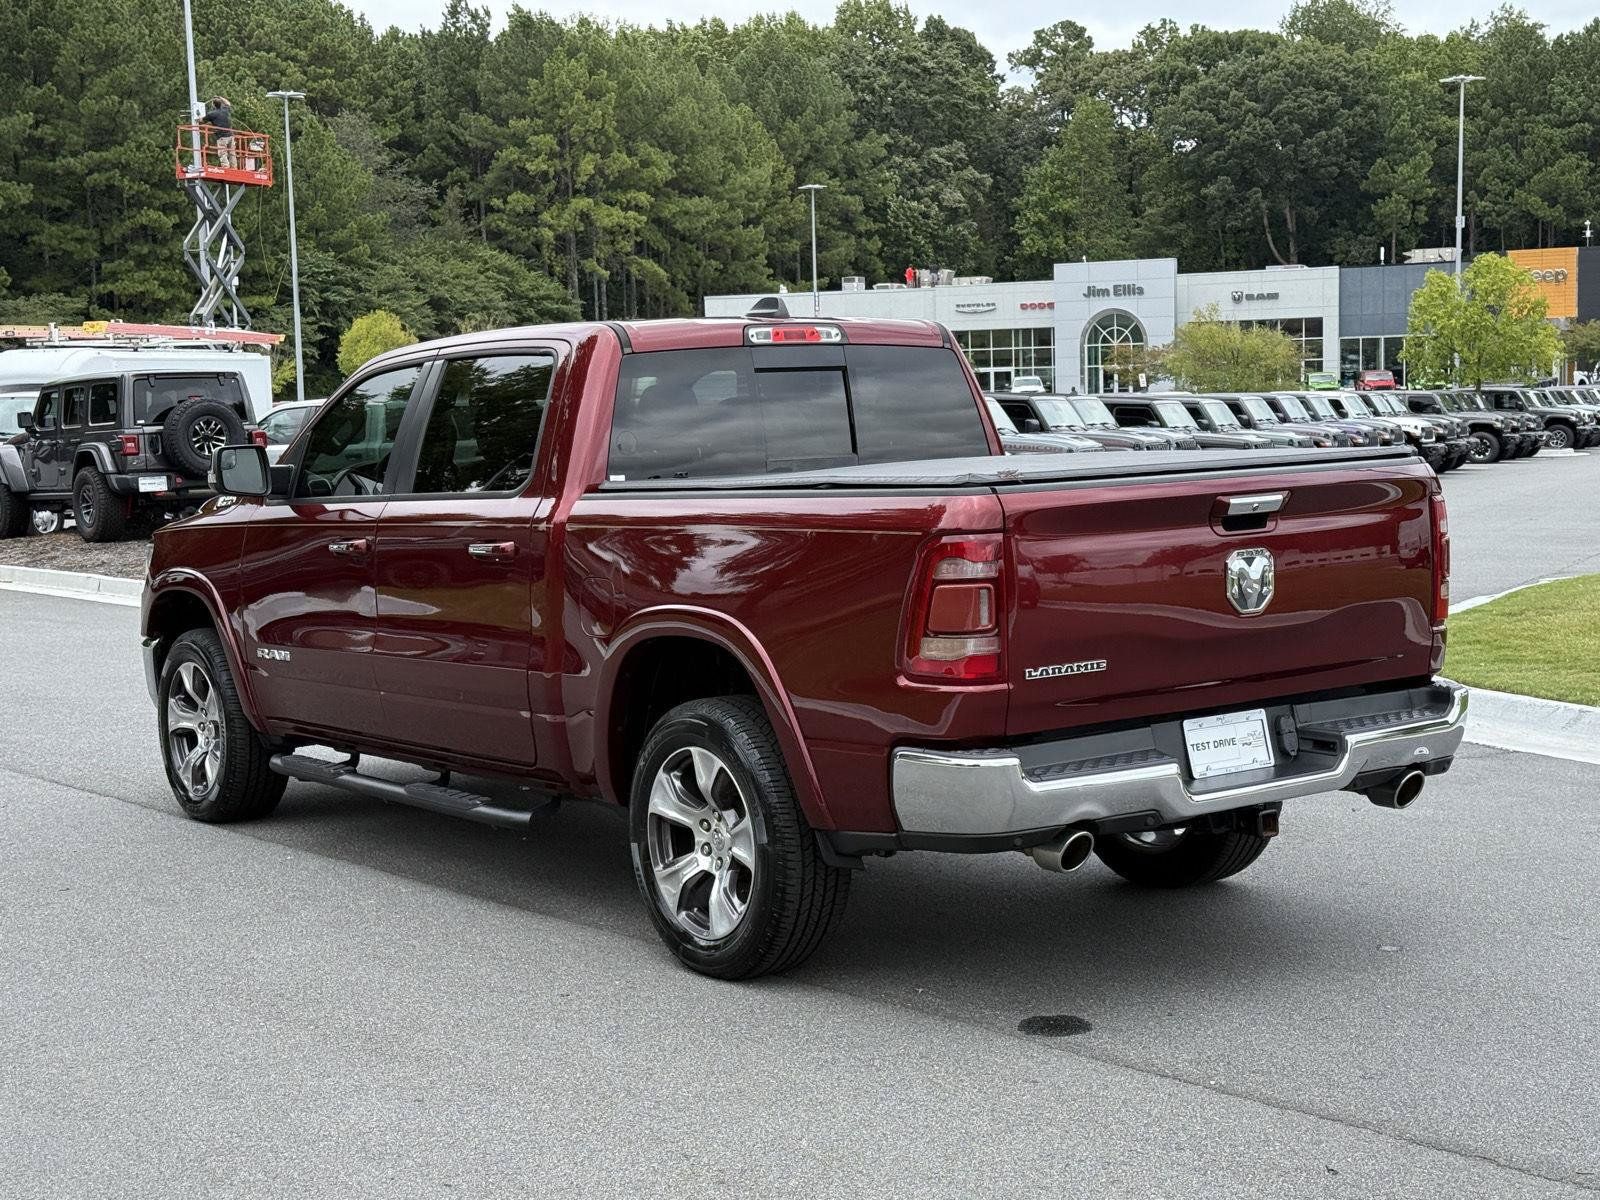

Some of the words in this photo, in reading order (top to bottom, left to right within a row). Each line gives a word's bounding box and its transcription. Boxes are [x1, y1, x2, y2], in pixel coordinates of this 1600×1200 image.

[1530, 268, 1567, 284] eep
[1082, 285, 1110, 298] Jim
[1113, 283, 1144, 297] Ellis
[1019, 302, 1055, 310] DODG
[256, 647, 291, 661] RAM
[1025, 659, 1107, 680] LARAMIE
[1190, 741, 1211, 752] TEST
[1213, 737, 1237, 749] DRIVE
